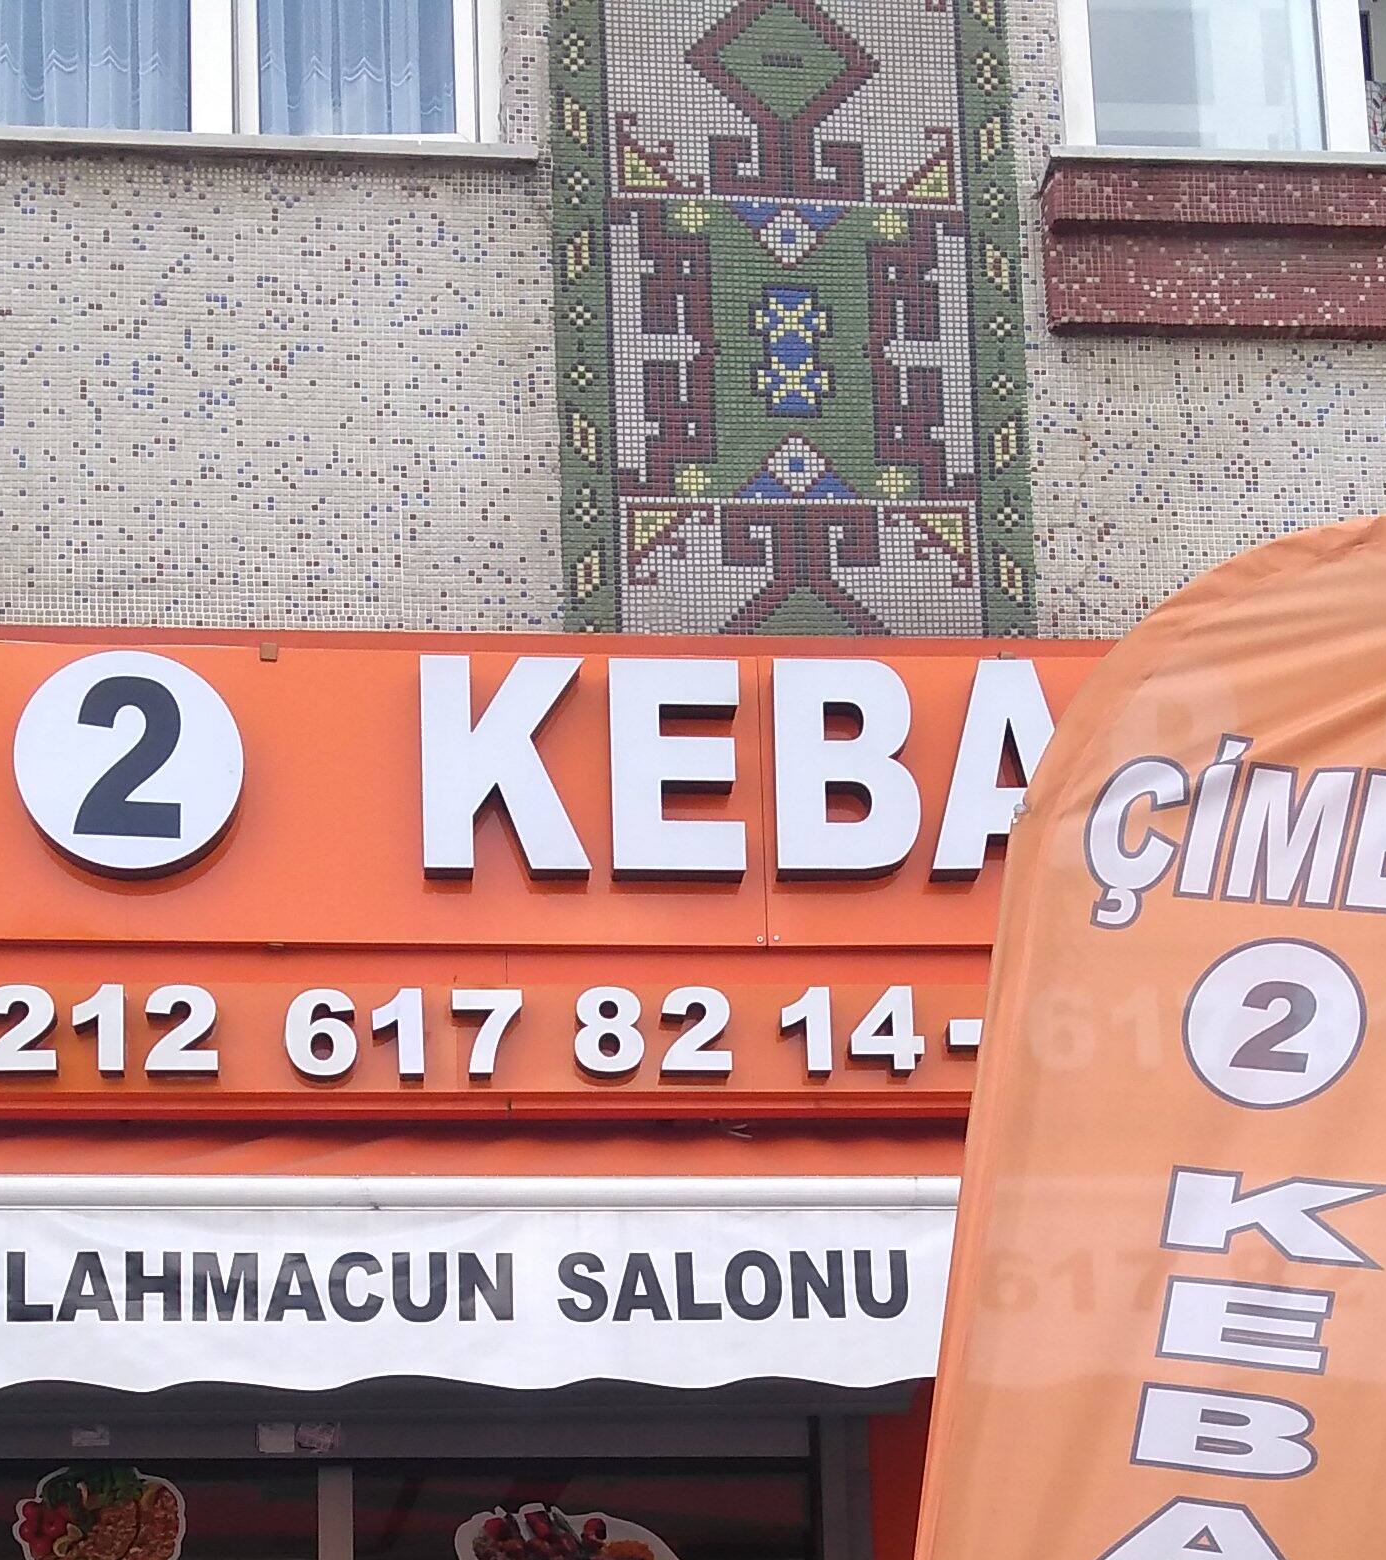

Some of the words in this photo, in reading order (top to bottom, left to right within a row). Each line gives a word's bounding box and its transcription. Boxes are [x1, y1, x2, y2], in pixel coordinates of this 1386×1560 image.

[73, 675, 182, 839] 2
[419, 654, 1057, 872] KEBA
[284, 987, 523, 1075] 617
[574, 986, 733, 1075] 82
[1229, 981, 1317, 1073] 2
[6, 1251, 514, 1323] LAHMACUN
[557, 1248, 910, 1323] SALONU
